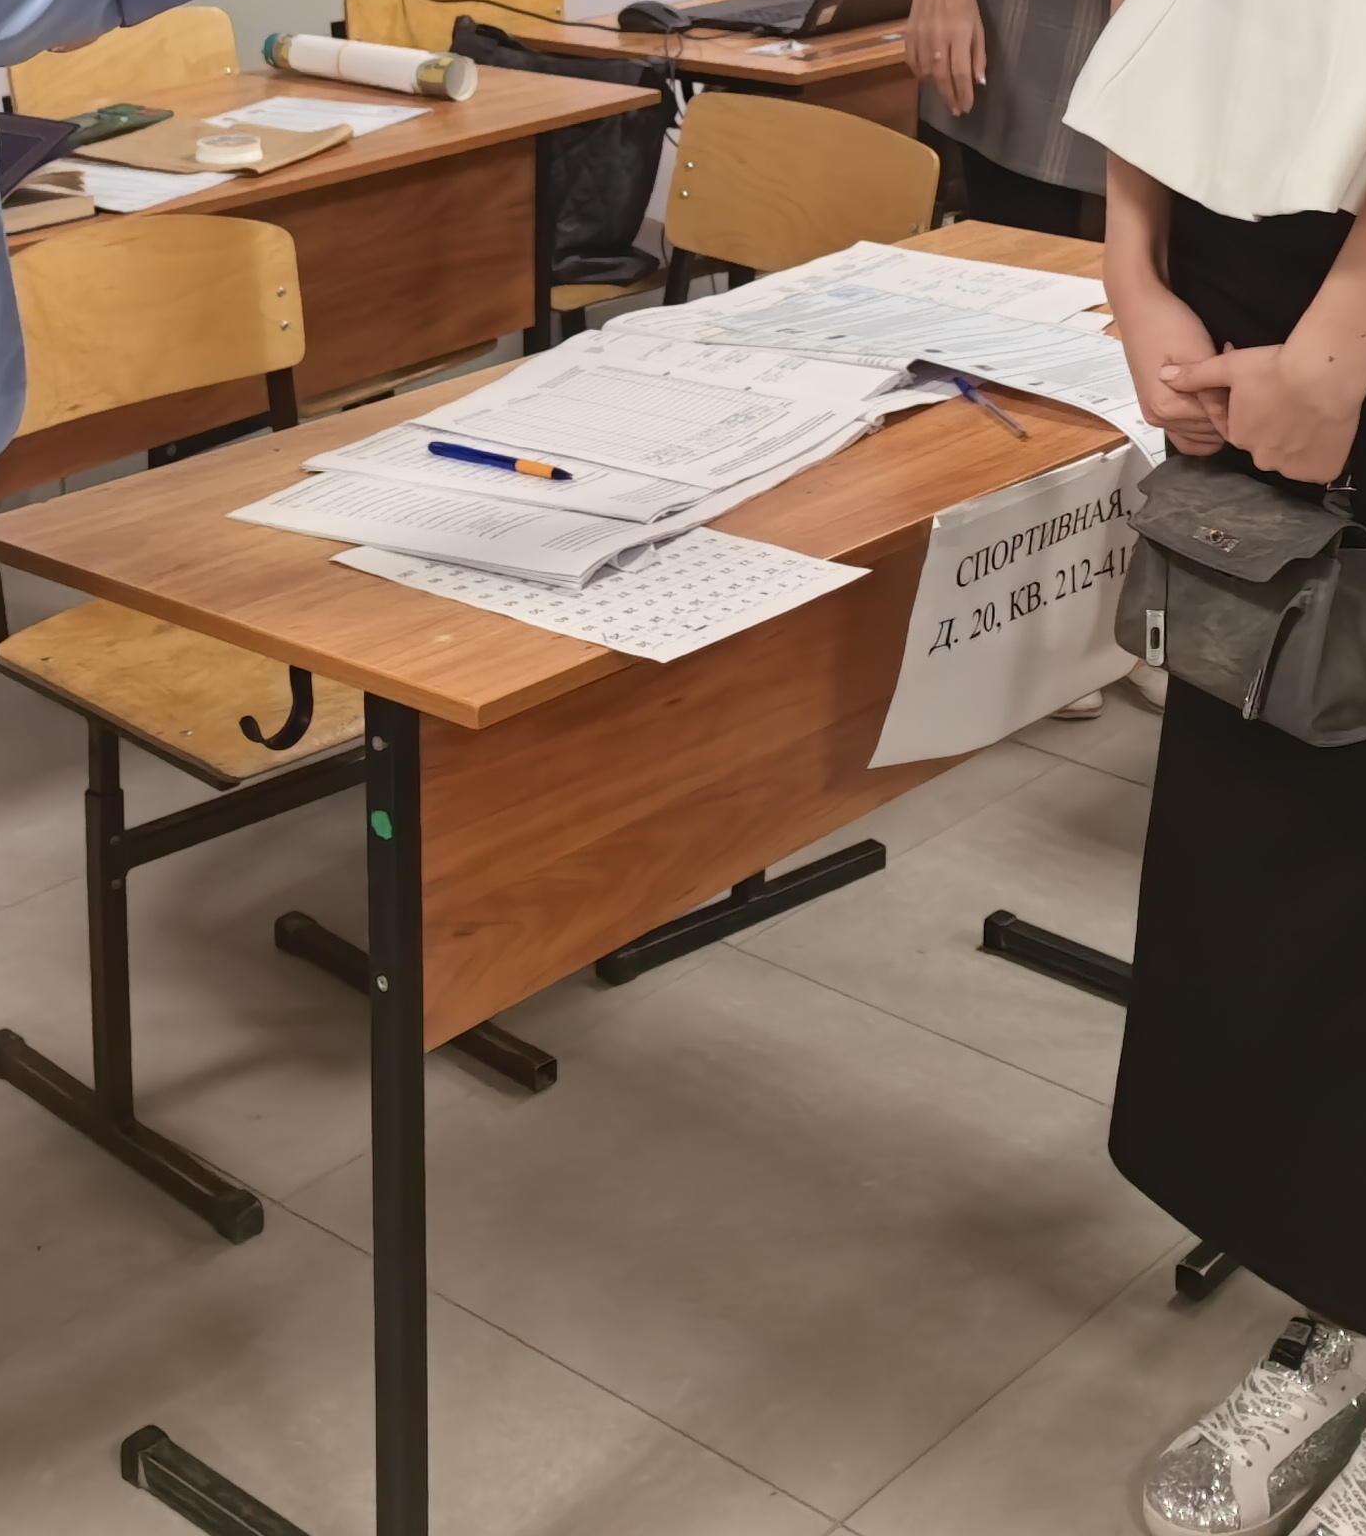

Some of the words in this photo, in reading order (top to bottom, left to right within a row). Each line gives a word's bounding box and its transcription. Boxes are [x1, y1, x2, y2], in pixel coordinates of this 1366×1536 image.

[955, 487, 1133, 588] СПОРТИВНАЯ,
[928, 617, 959, 657] Д.
[969, 601, 1002, 639] 20,
[1009, 581, 1048, 622] КВ.
[1055, 544, 1138, 600] 212-41
